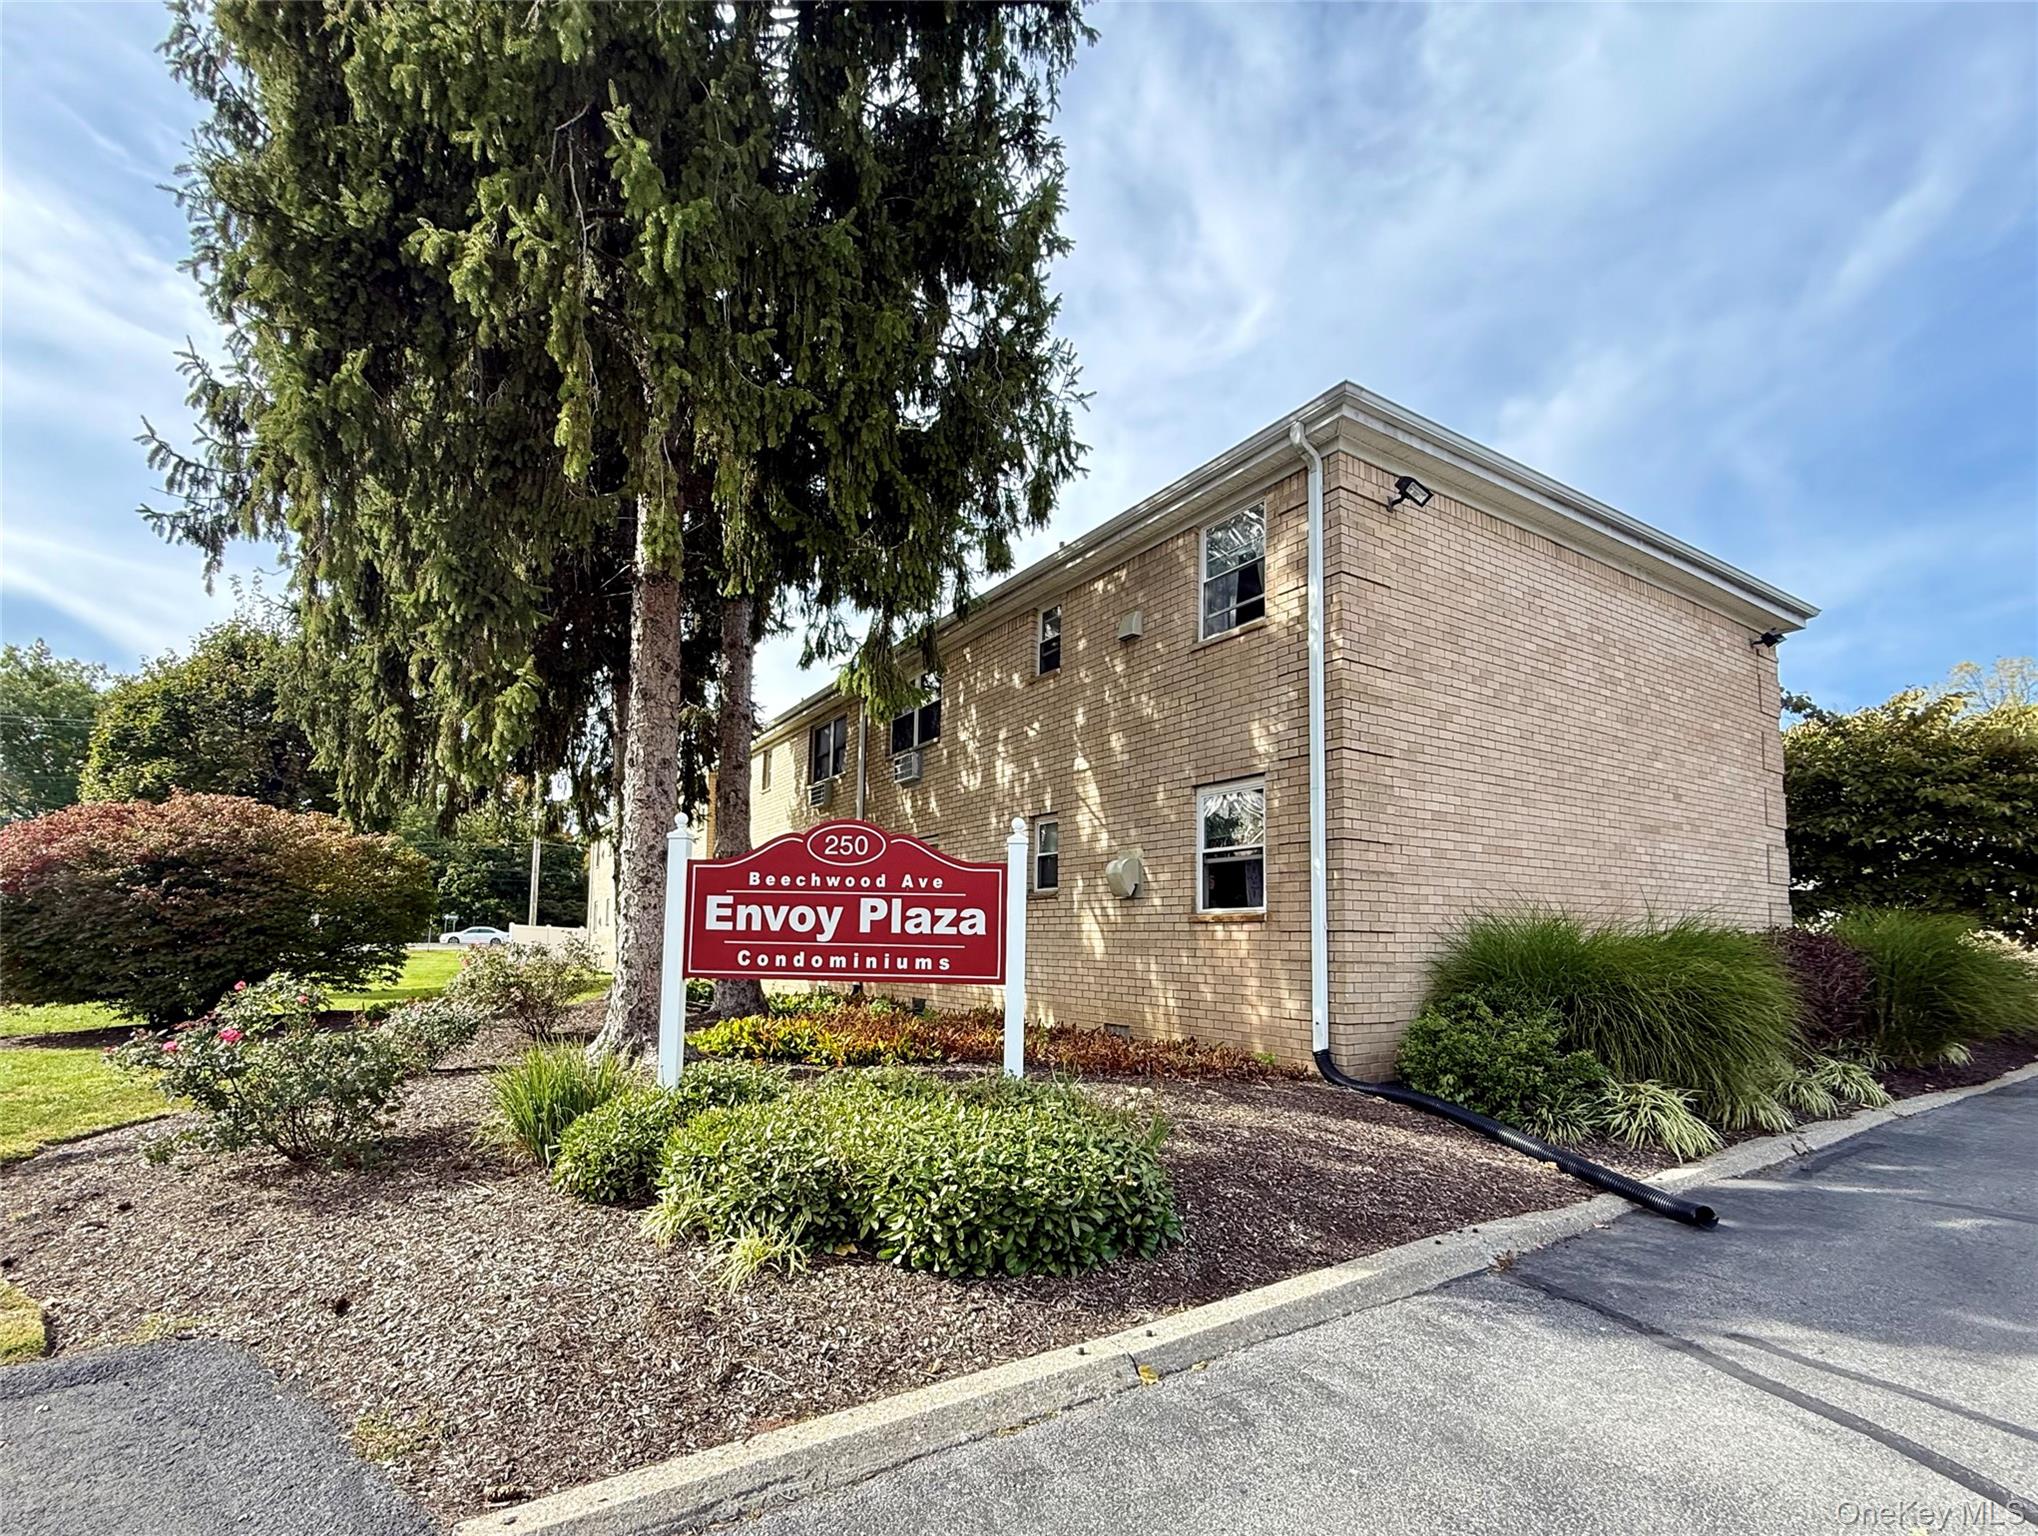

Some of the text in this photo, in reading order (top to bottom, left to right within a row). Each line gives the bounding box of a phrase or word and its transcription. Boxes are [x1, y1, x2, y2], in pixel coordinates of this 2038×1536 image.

[824, 835, 869, 857] 250
[748, 871, 944, 889] Beechwood Ave
[705, 895, 987, 942] Envoy Plaza
[737, 950, 951, 970] Condominiums
